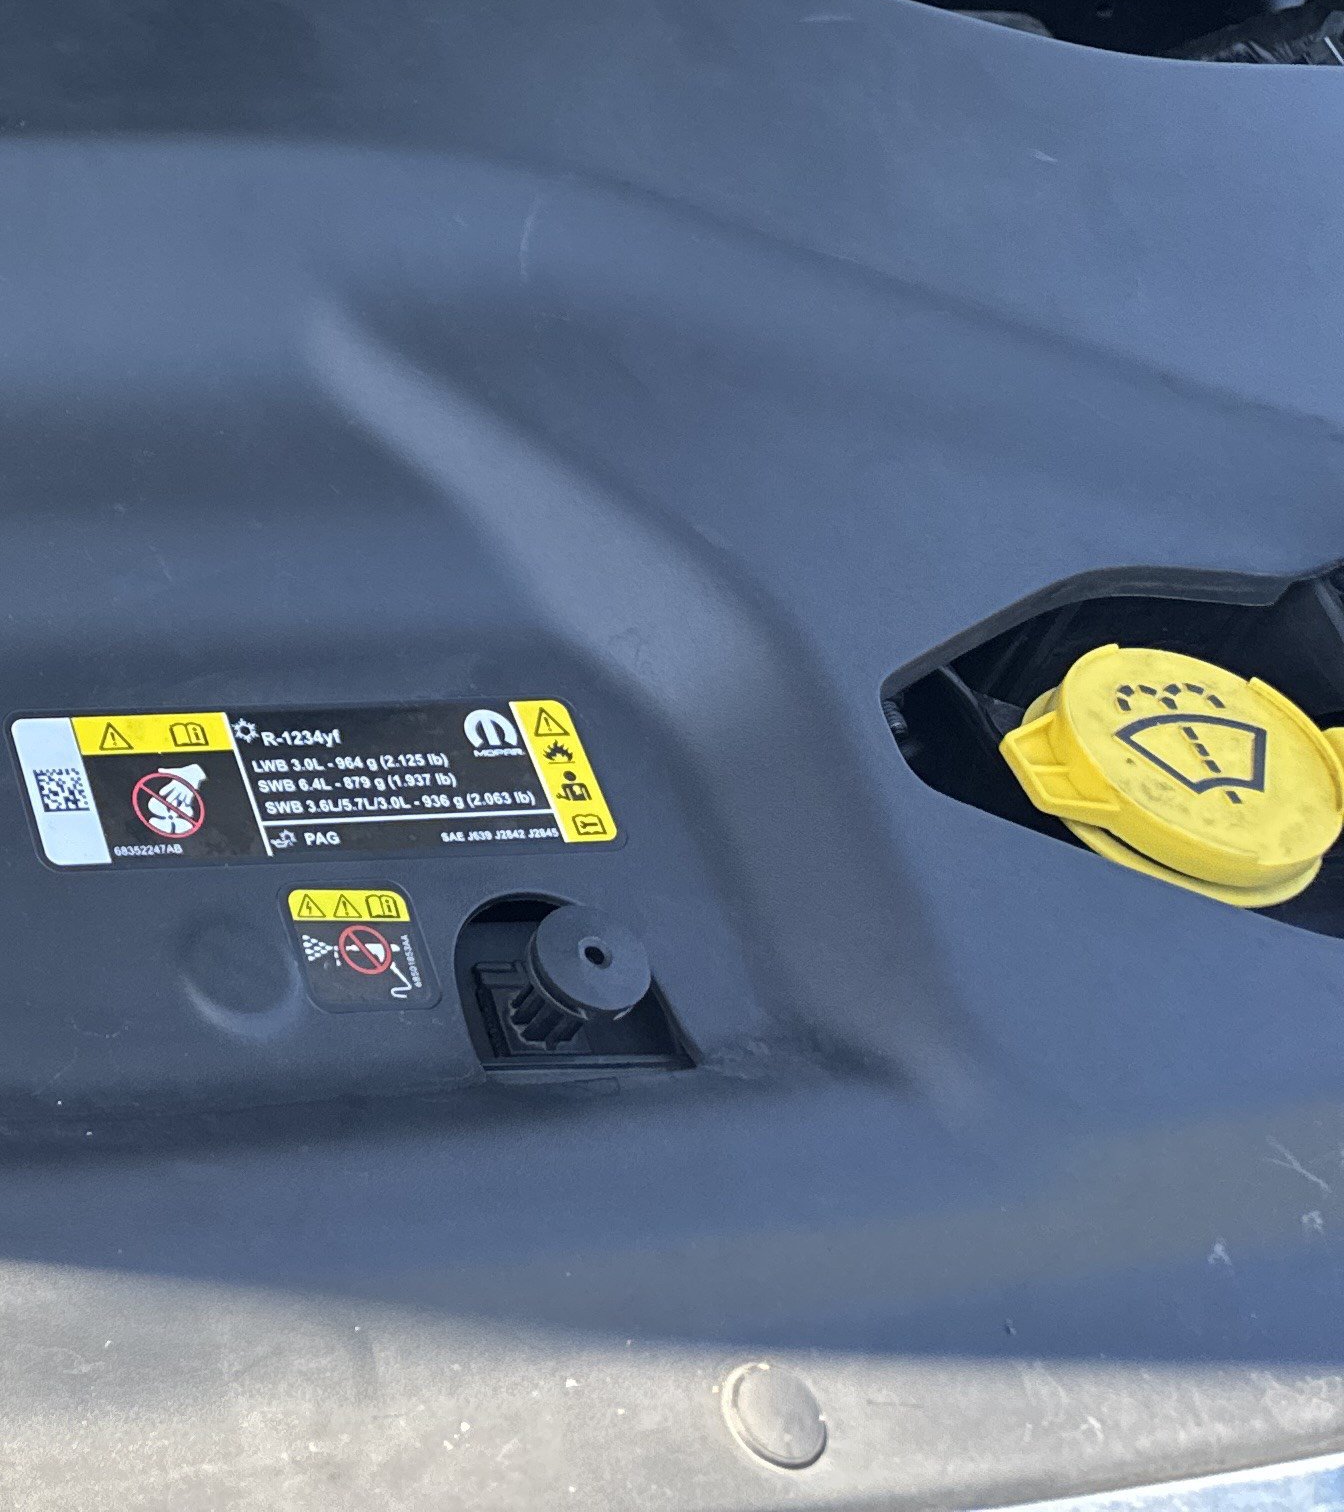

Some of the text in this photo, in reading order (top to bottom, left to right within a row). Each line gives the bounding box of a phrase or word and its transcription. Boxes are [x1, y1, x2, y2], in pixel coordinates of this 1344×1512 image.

[260, 728, 342, 748] R-1234yf
[251, 759, 289, 773] LWB
[291, 757, 326, 772] 3.0L
[334, 756, 364, 769] 964
[366, 758, 379, 772] g
[379, 753, 425, 770] (2.125
[427, 752, 450, 768] lb)
[257, 778, 297, 793] SWB
[298, 777, 333, 792] 6.4L
[342, 775, 372, 790] 879
[374, 777, 386, 791] g
[387, 773, 431, 790] (1.937
[435, 772, 457, 788] lb)
[264, 799, 304, 814] SWB
[305, 795, 412, 813] 3.6L/5.7L/3.0L
[421, 794, 451, 808] 936
[453, 796, 465, 810] g
[466, 791, 512, 808] (2.063
[513, 790, 536, 806] lb)
[303, 830, 341, 846] PAG
[440, 831, 465, 843] SAE
[113, 843, 185, 856] 68352247AB
